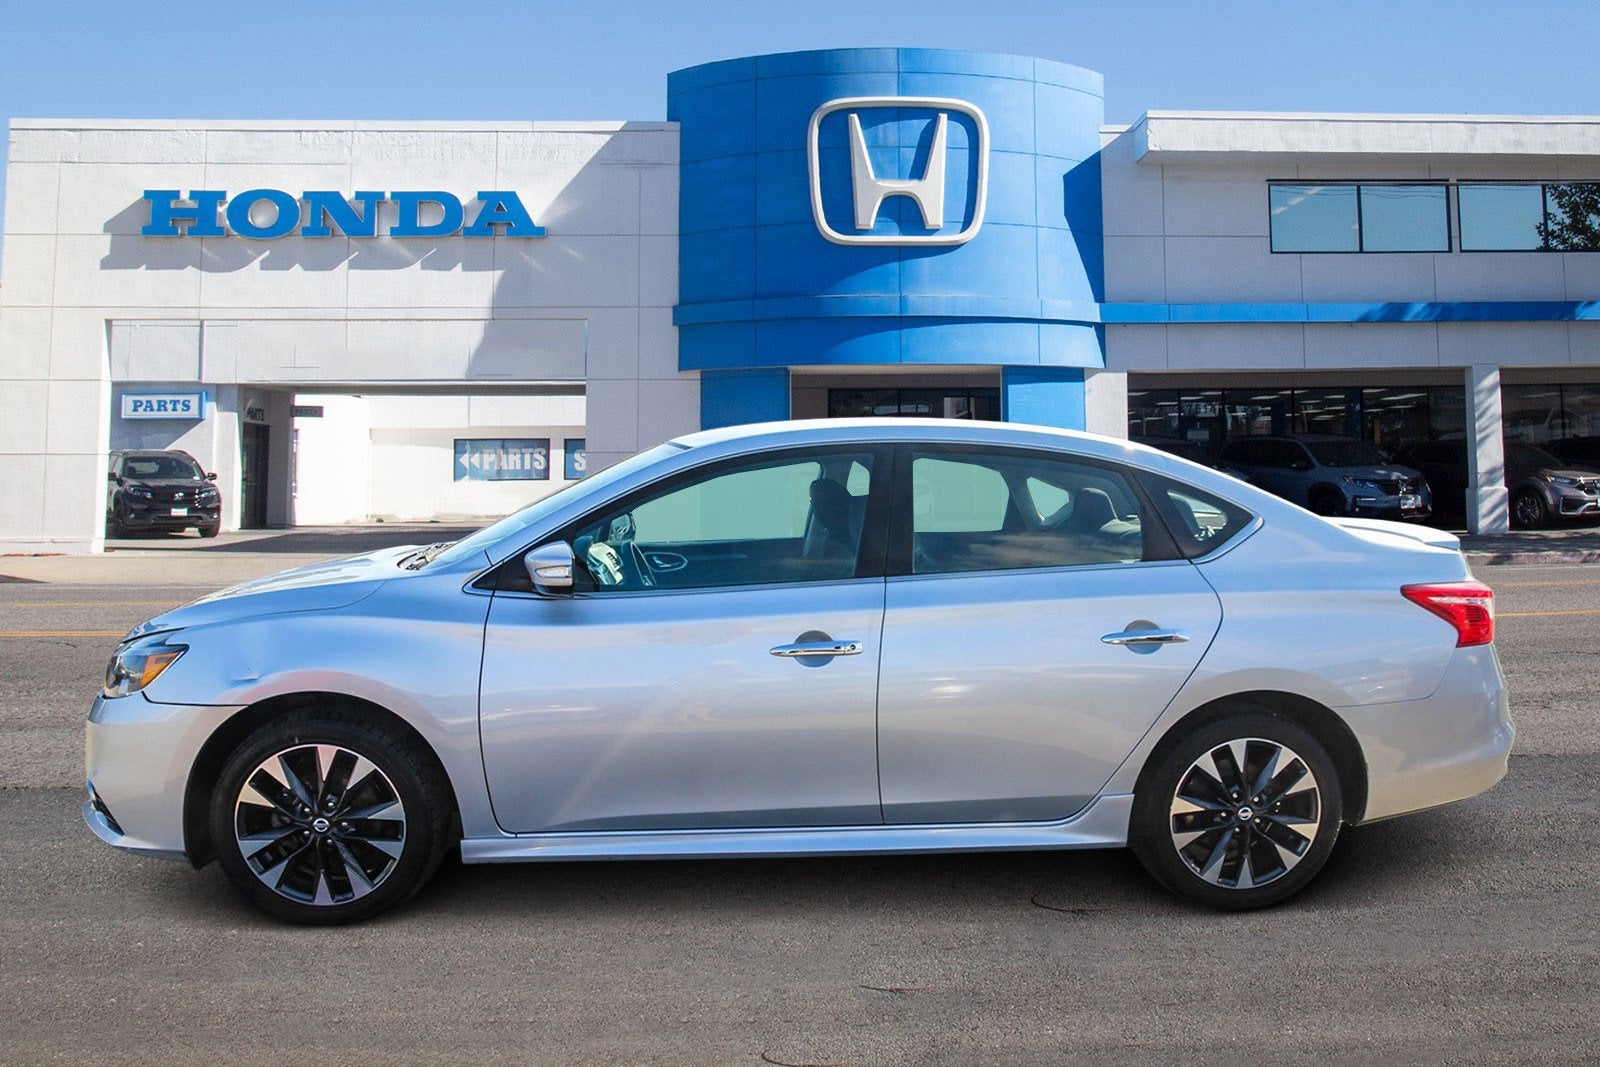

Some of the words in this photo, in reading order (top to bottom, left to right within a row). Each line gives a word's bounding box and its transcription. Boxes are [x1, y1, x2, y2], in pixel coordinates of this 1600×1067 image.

[141, 188, 547, 239] HONDA
[132, 399, 191, 412] PARTS
[247, 407, 265, 421] PARTS
[483, 447, 547, 471] PARTS
